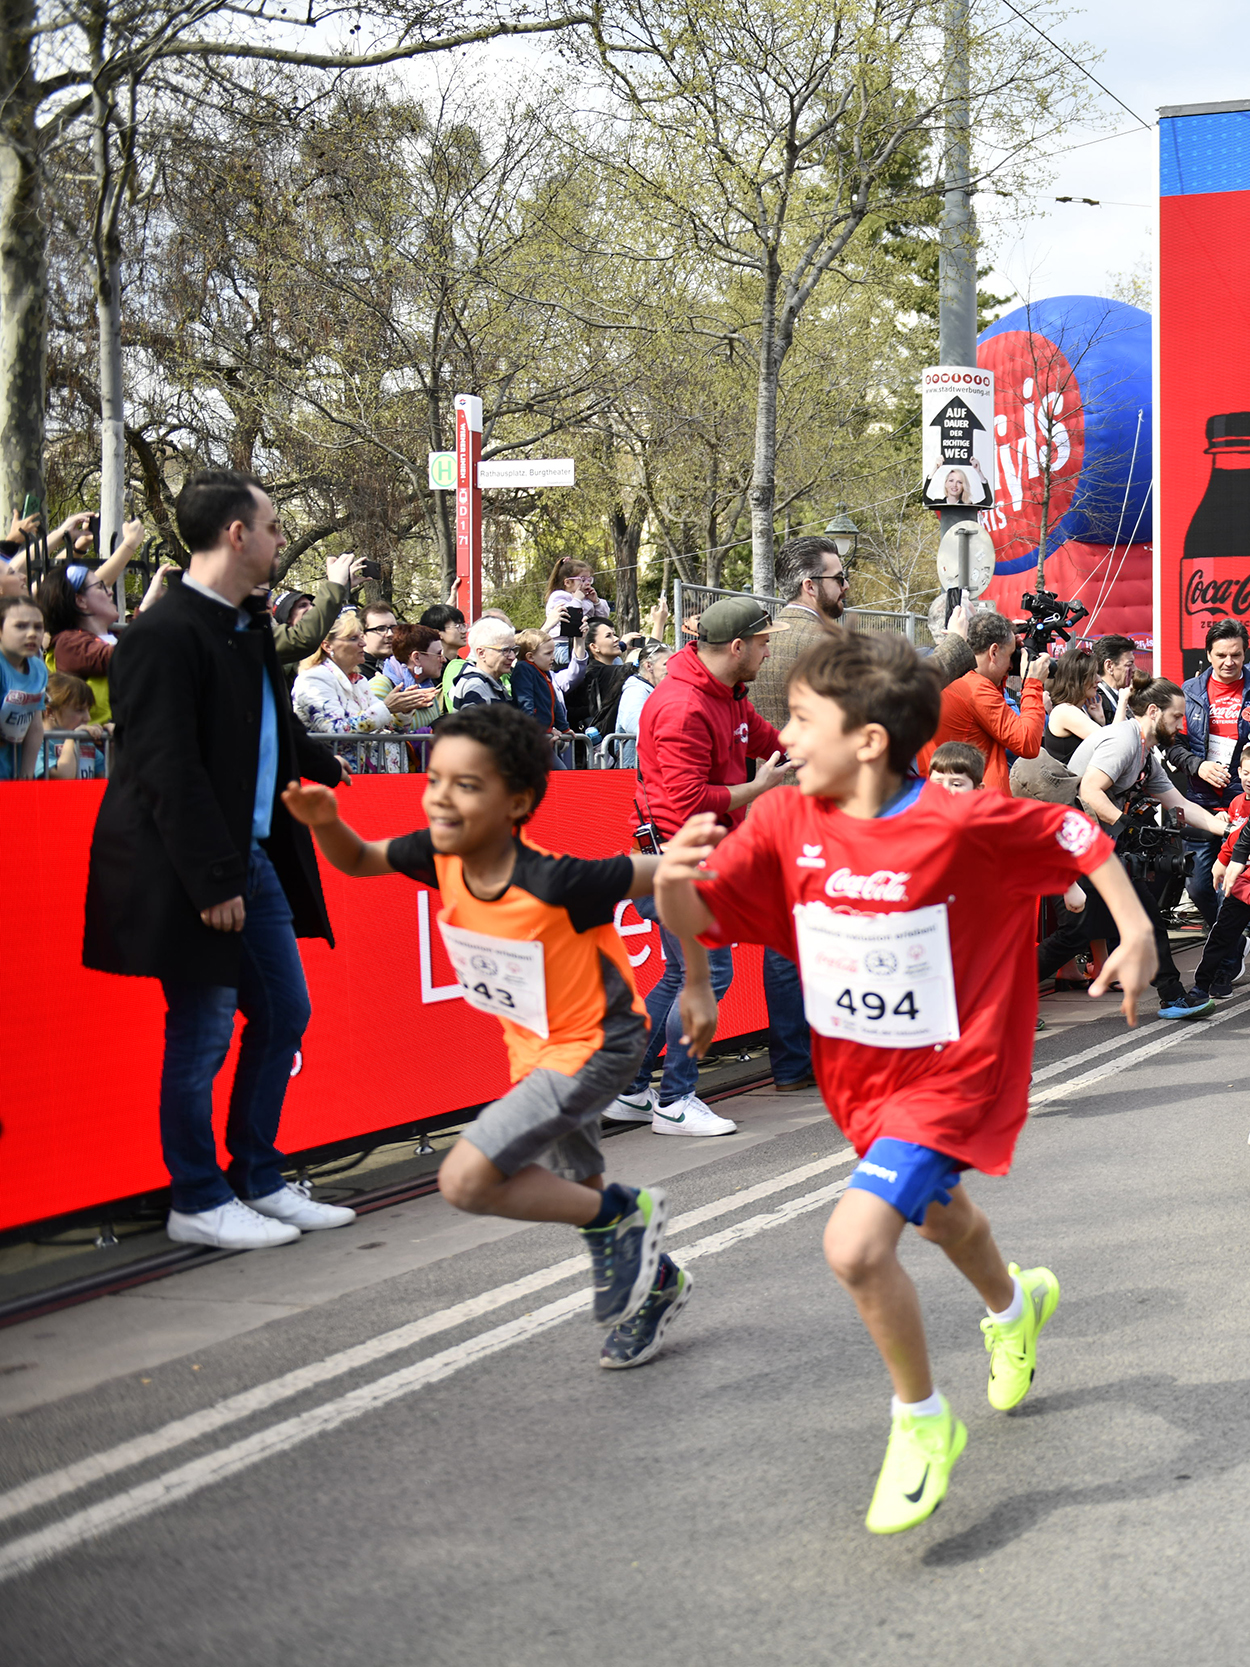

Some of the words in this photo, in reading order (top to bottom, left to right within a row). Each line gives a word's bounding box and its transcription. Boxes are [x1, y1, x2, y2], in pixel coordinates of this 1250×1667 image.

[945, 407, 967, 418] AUF
[944, 419, 969, 428] DAUER
[459, 423, 467, 453] WIENER
[949, 429, 963, 437] DER
[942, 439, 970, 447] RICHTIGE
[994, 377, 1071, 512] rvis
[944, 448, 968, 459] WEG
[438, 460, 452, 481] H
[459, 453, 467, 479] LINIEN
[529, 468, 571, 478] Burgtheater
[459, 505, 468, 516] D
[460, 520, 466, 531] 1
[458, 535, 468, 546] 71
[825, 867, 911, 902] Coca-Cola
[463, 982, 516, 1009] 43
[836, 988, 920, 1021] 494
